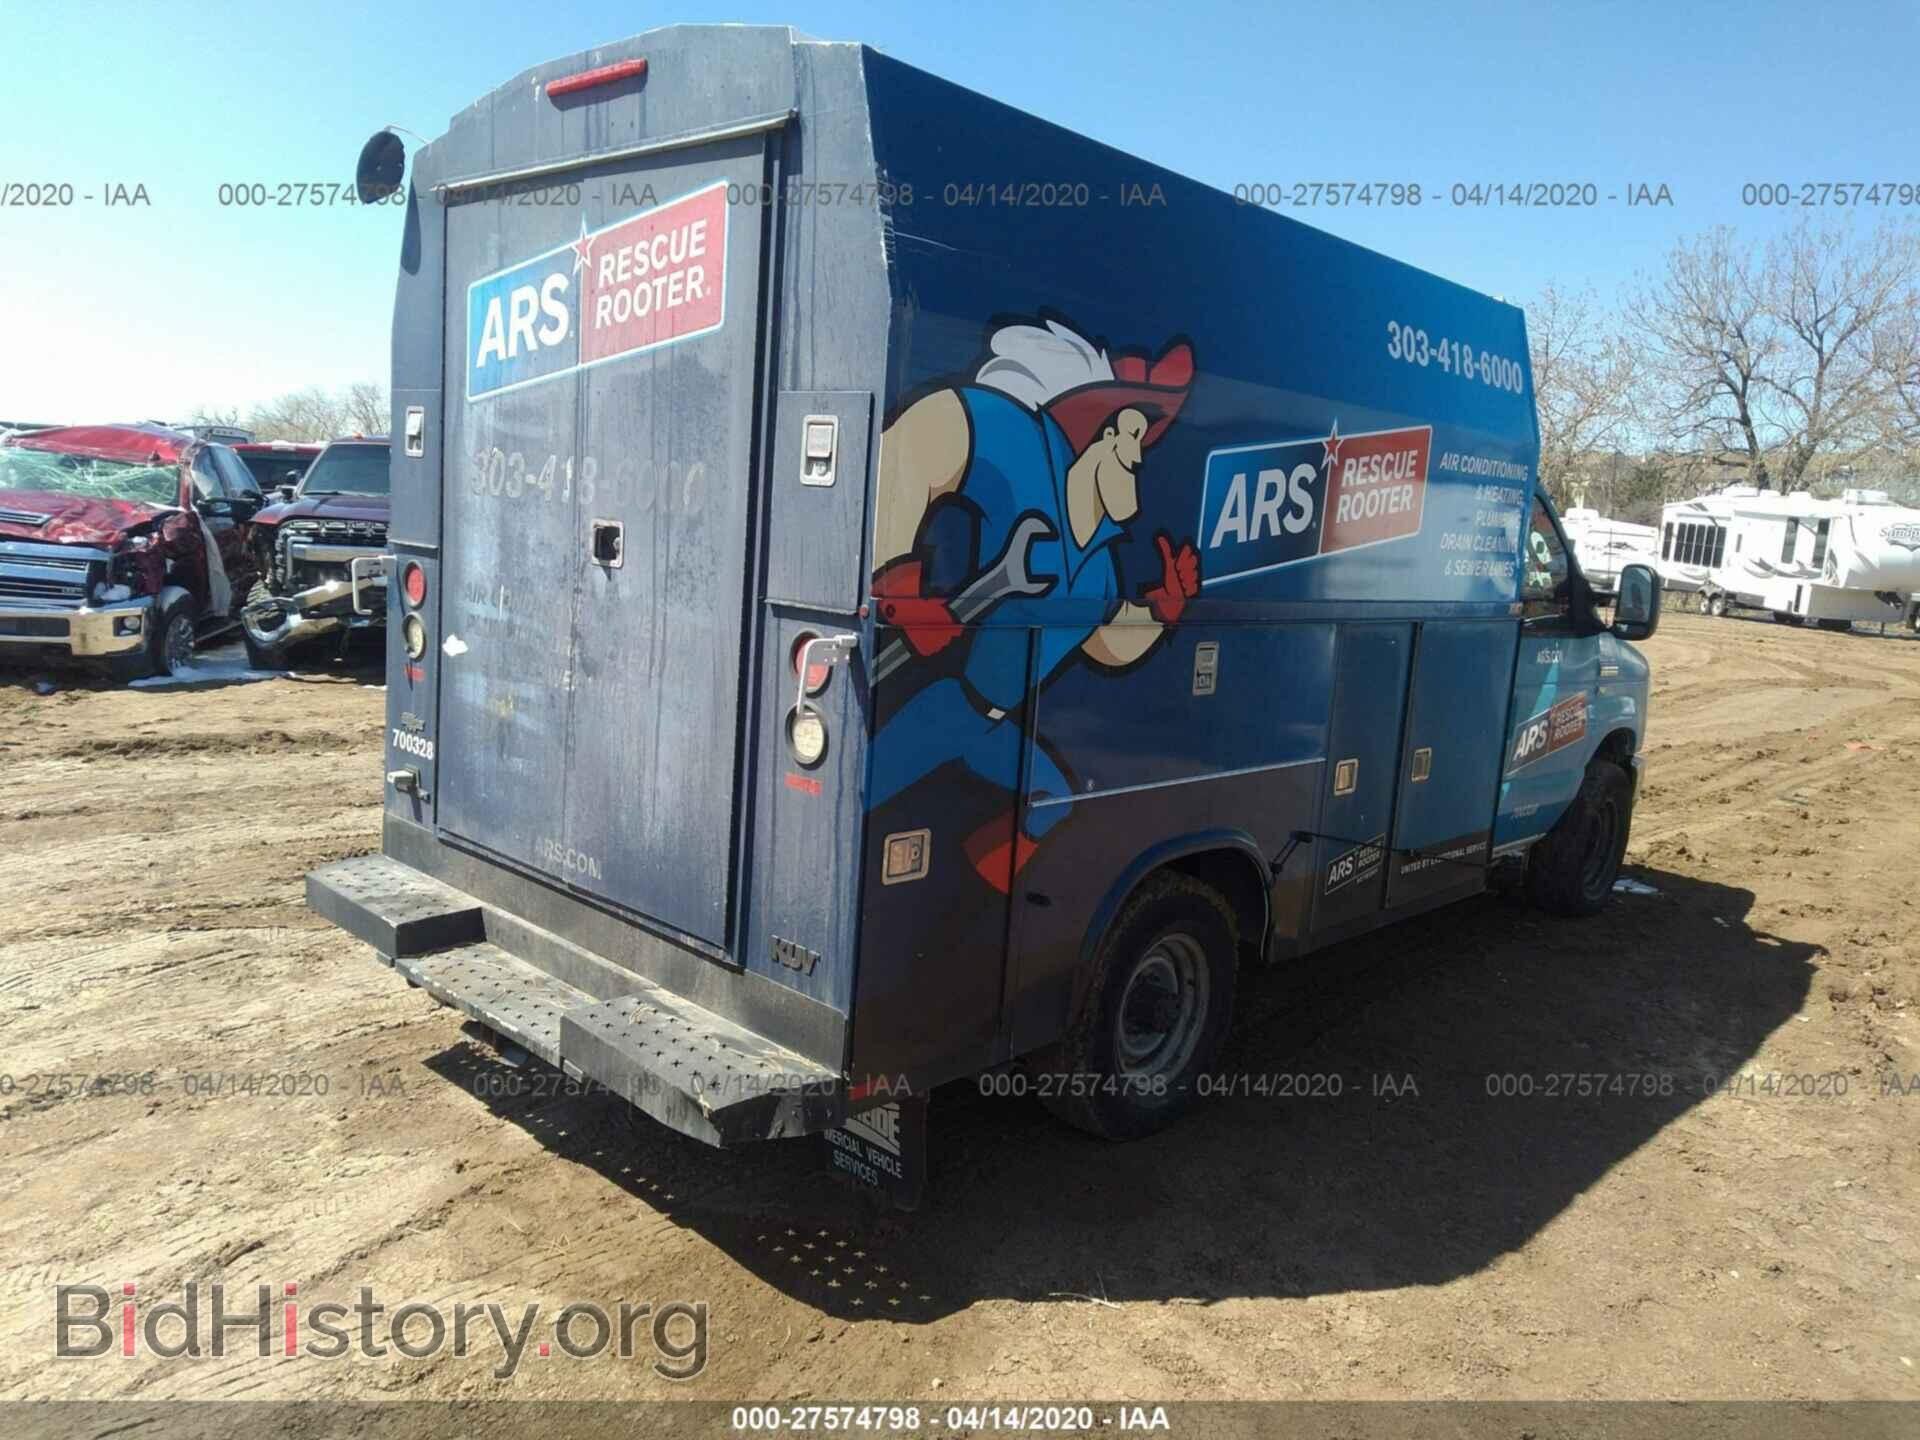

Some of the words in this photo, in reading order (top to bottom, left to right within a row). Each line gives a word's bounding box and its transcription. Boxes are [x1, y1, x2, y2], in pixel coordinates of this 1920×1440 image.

[598, 219, 707, 288] RESCUE
[595, 266, 705, 329] ROOTER
[476, 273, 571, 368] ARS
[1387, 320, 1523, 394] 303-418-6000
[1341, 450, 1418, 488] RESCUE
[1440, 452, 1459, 471] AIR
[1461, 456, 1528, 481] CONDITIONING
[1210, 464, 1318, 548] ARS
[1336, 484, 1414, 523] ROOTER
[1486, 485, 1524, 505] HEATING
[1440, 533, 1472, 551] DRAIN
[392, 728, 433, 760] 700328
[1512, 720, 1549, 761] ARS
[1327, 856, 1354, 886] ARS
[771, 934, 821, 977] KUV
[833, 1150, 879, 1186] SERVICES
[866, 1147, 902, 1178] VEHICLE
